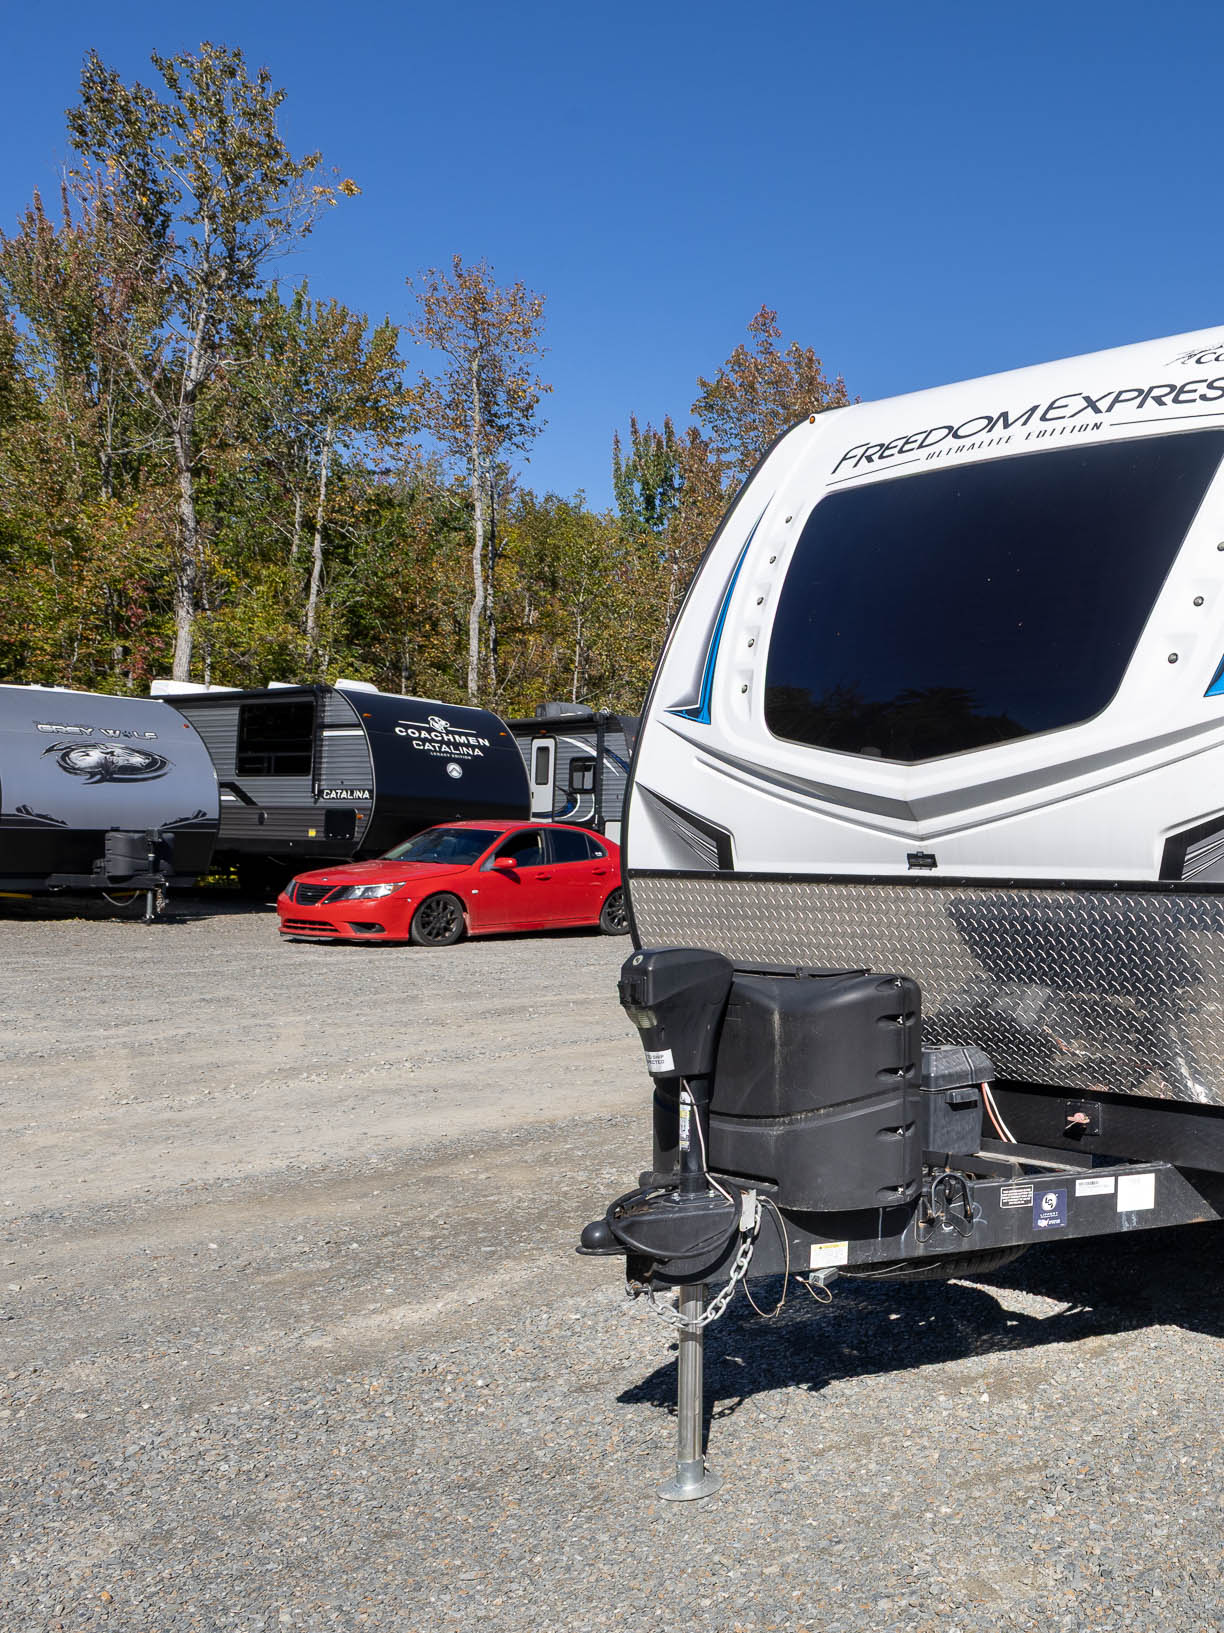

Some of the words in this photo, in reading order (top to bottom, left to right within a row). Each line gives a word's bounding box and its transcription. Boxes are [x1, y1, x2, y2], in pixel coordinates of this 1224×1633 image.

[831, 404, 1042, 475] FREEDOM
[1025, 421, 1103, 441] EDITION
[36, 723, 94, 736] GREY
[394, 727, 490, 747] COACHMEN
[412, 740, 484, 757] CATALINA
[323, 789, 370, 799] CATALINA
